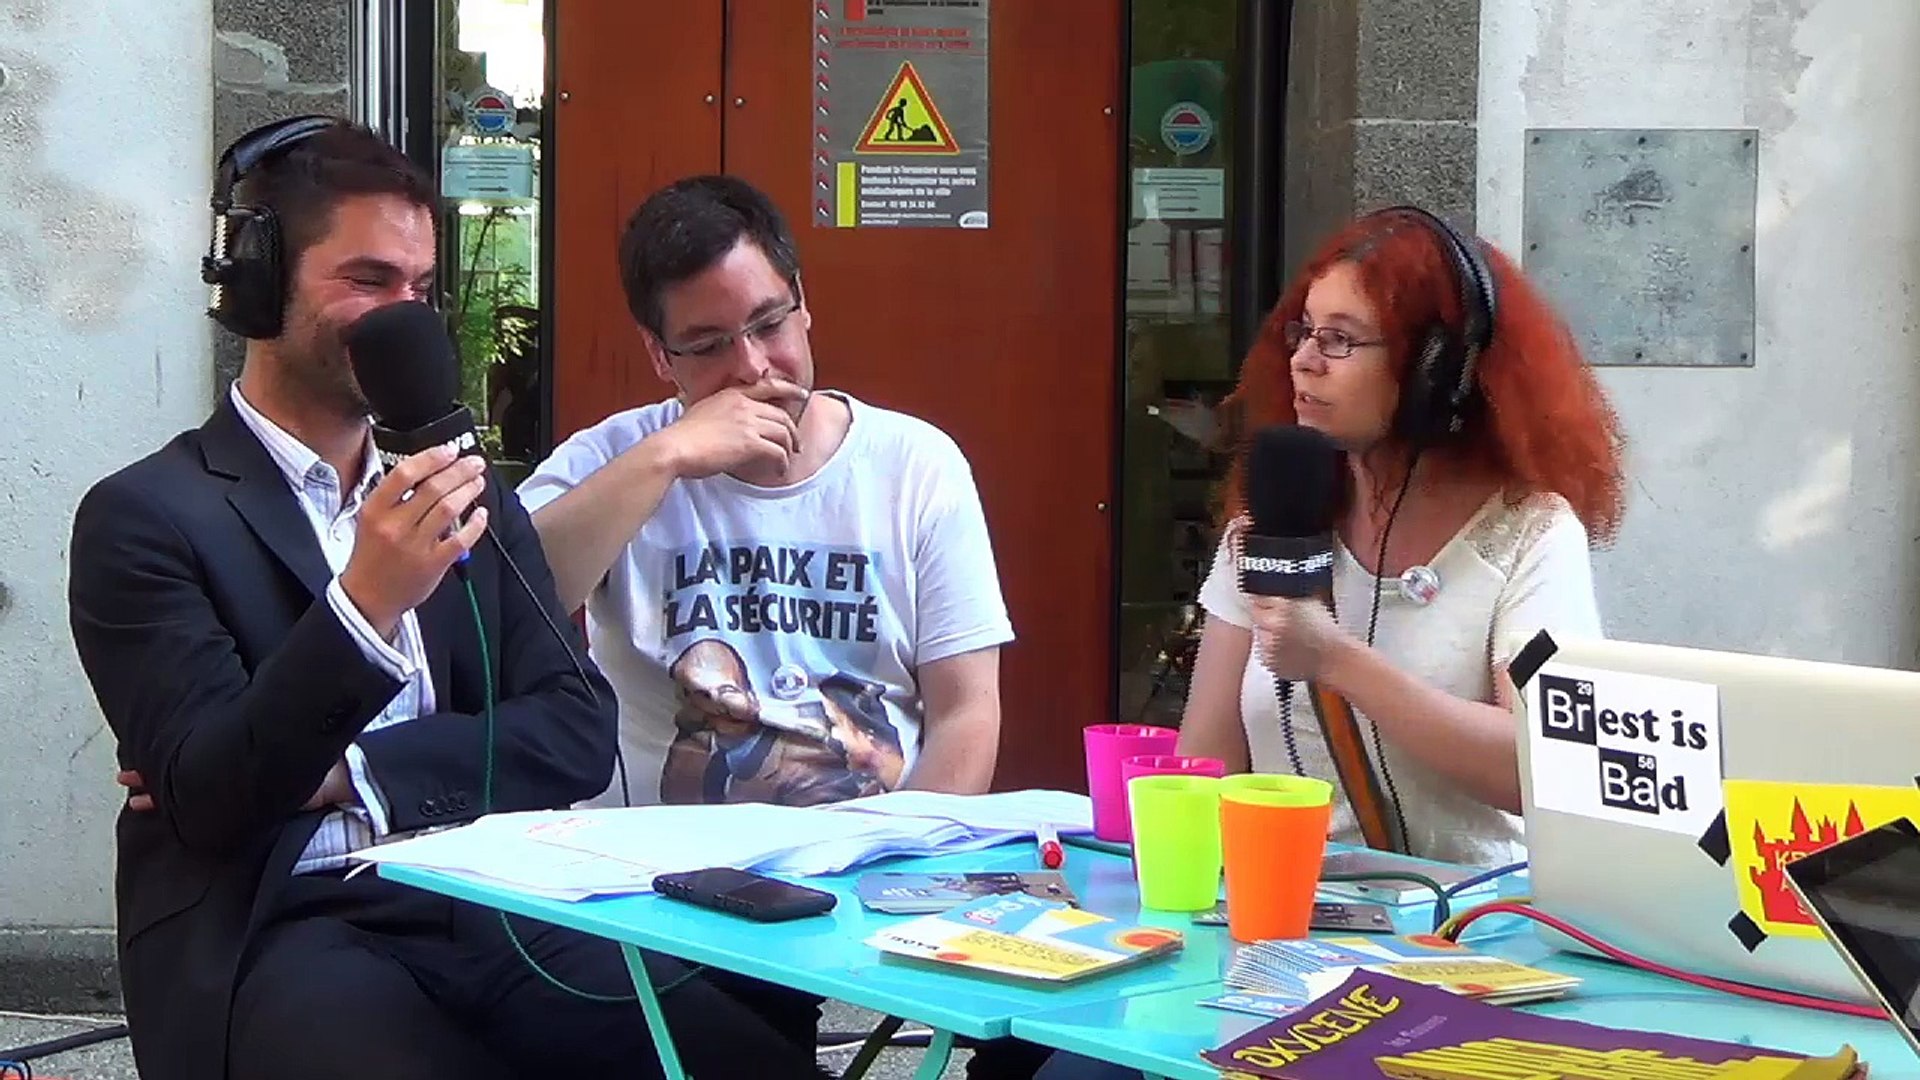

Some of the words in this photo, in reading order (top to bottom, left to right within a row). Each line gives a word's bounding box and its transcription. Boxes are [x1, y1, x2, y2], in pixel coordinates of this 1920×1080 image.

[675, 549, 721, 591] LA
[730, 546, 815, 588] PAIX
[826, 552, 869, 592] ET
[666, 594, 718, 638] LA
[726, 586, 879, 642] SÉCURITÉ
[1547, 688, 1660, 743] Brest
[1671, 710, 1708, 750] is
[1601, 761, 1689, 811] Bad
